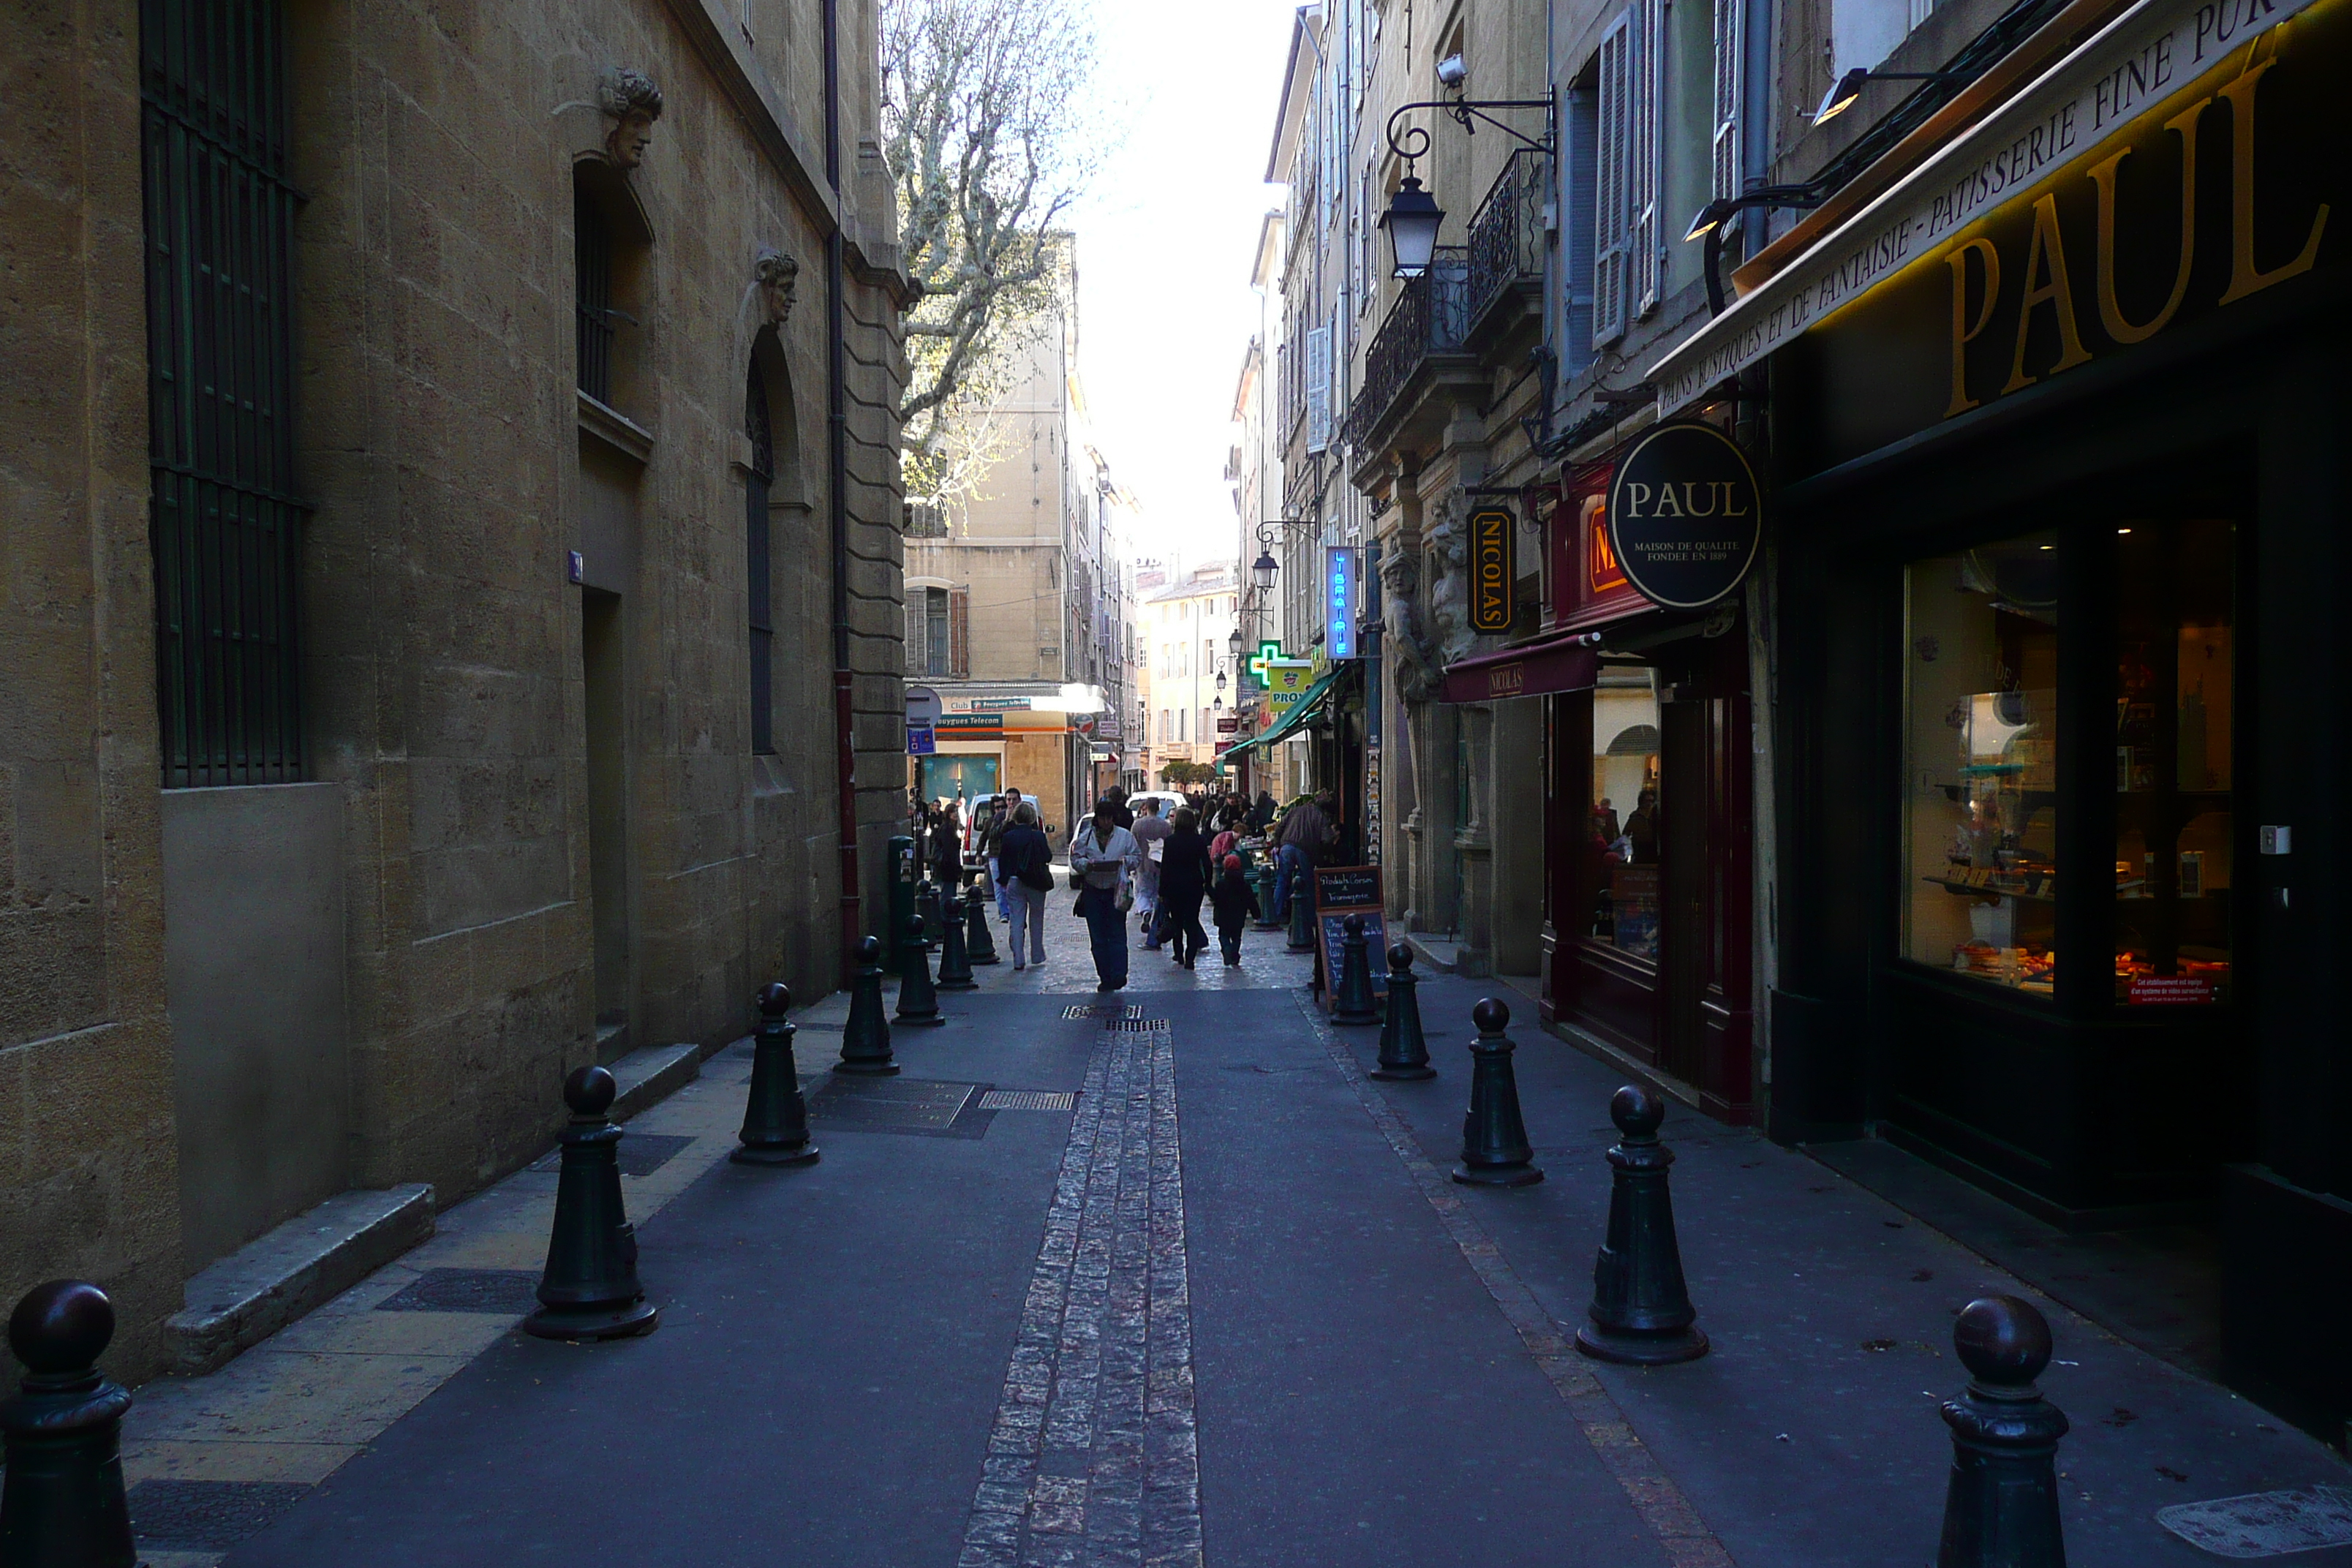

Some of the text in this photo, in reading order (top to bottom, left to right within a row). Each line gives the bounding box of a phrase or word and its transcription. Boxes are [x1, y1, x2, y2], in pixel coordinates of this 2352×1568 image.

[1662, 366, 1693, 410] PAINS
[1698, 320, 1763, 389] RUSTIQUES
[1768, 304, 1787, 344] ET
[1790, 286, 1812, 330] DE
[1817, 217, 1912, 312] FANTAISIE
[1928, 99, 2078, 238] PATISSERIE
[2092, 31, 2176, 131] FINE
[1943, 56, 2331, 419] PAUL
[1626, 480, 1749, 519] PAUL
[1634, 541, 1675, 552] MAISON
[1678, 541, 1692, 551] DE
[1647, 551, 1727, 562] FONDEE EN 1889
[1482, 519, 1503, 622] NICOLAS
[1334, 551, 1346, 654] LIBRAIRIE
[1490, 667, 1523, 691] NICOLAS
[951, 701, 968, 709] Club
[1273, 693, 1303, 703] PRO
[938, 717, 999, 725] ouygues Telecom
